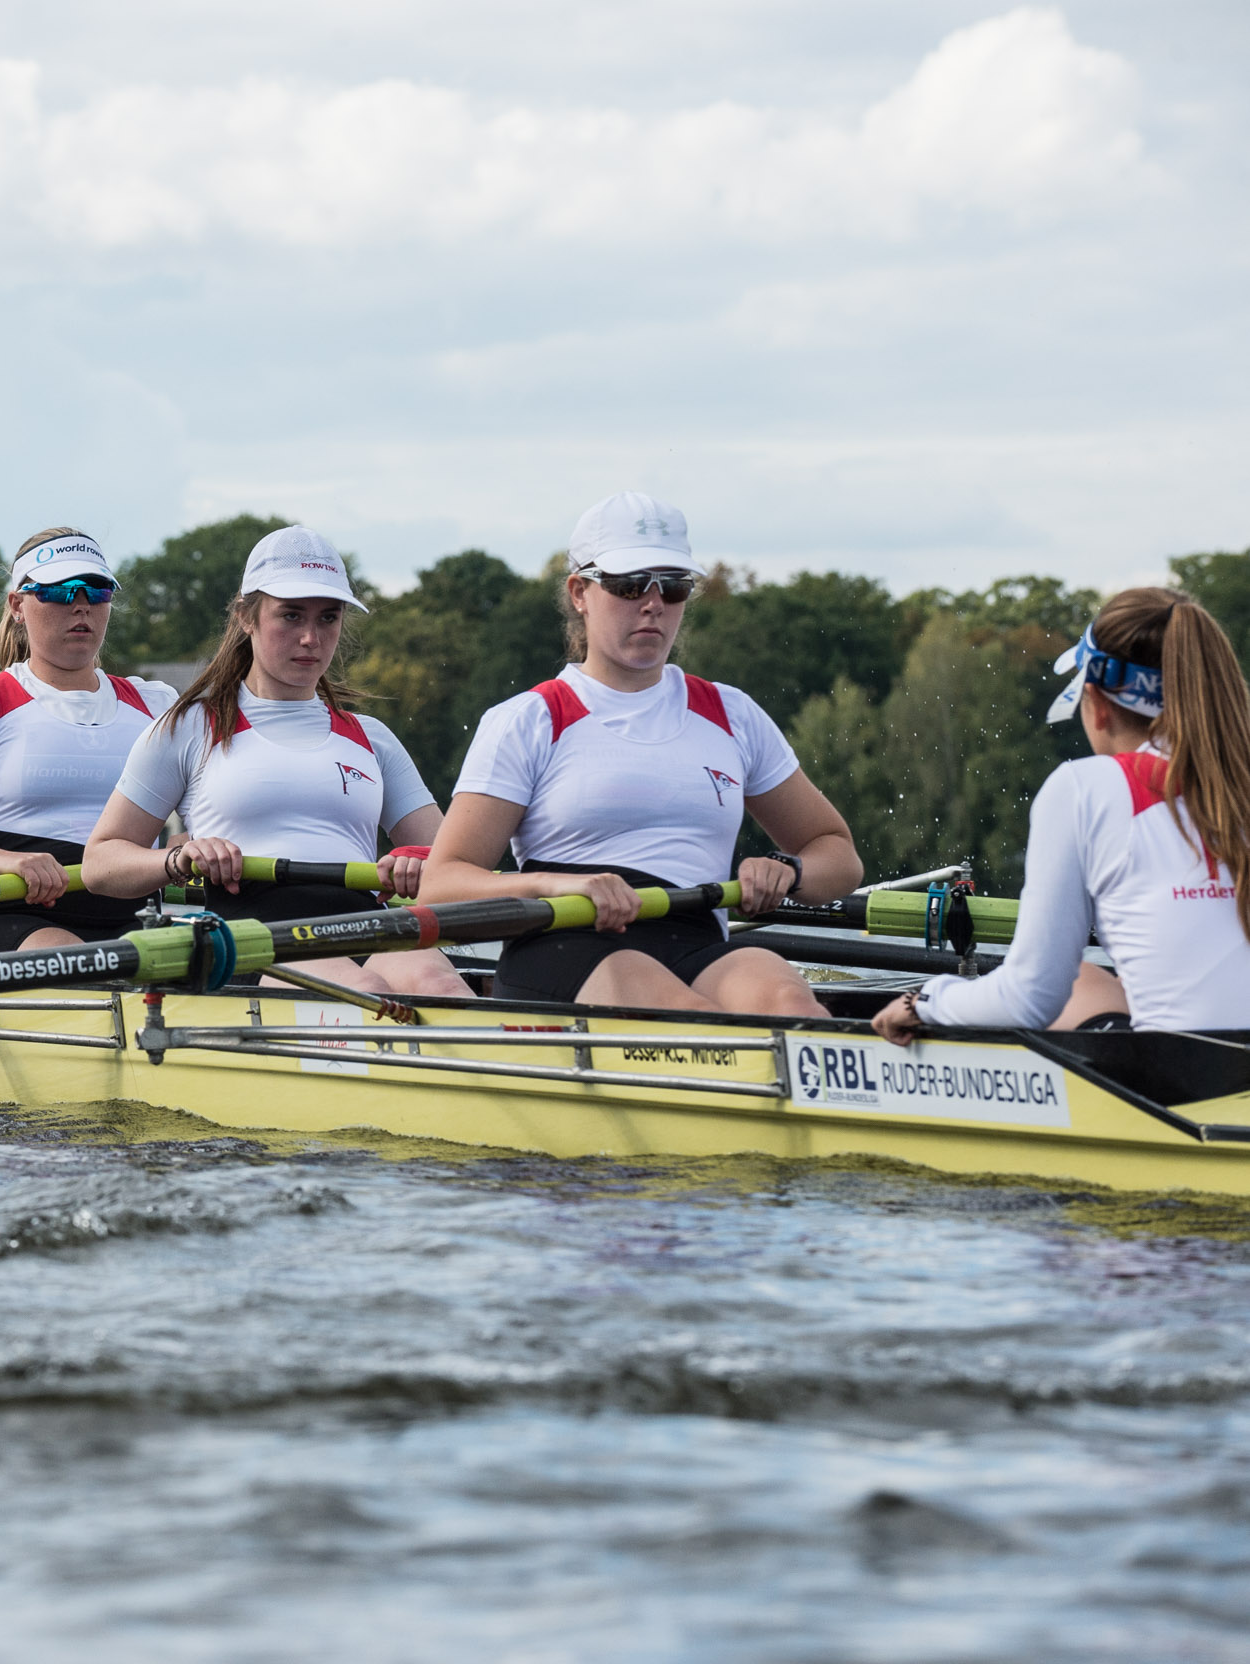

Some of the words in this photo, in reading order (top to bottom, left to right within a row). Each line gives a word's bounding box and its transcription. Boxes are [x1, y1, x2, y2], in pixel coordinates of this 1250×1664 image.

[55, 543, 86, 554] world
[300, 562, 338, 574] ROWING
[313, 919, 371, 936] concept
[371, 918, 383, 930] 2
[822, 1047, 877, 1092] RBL
[881, 1061, 1058, 1106] RUDER-BUNDESLIGA
